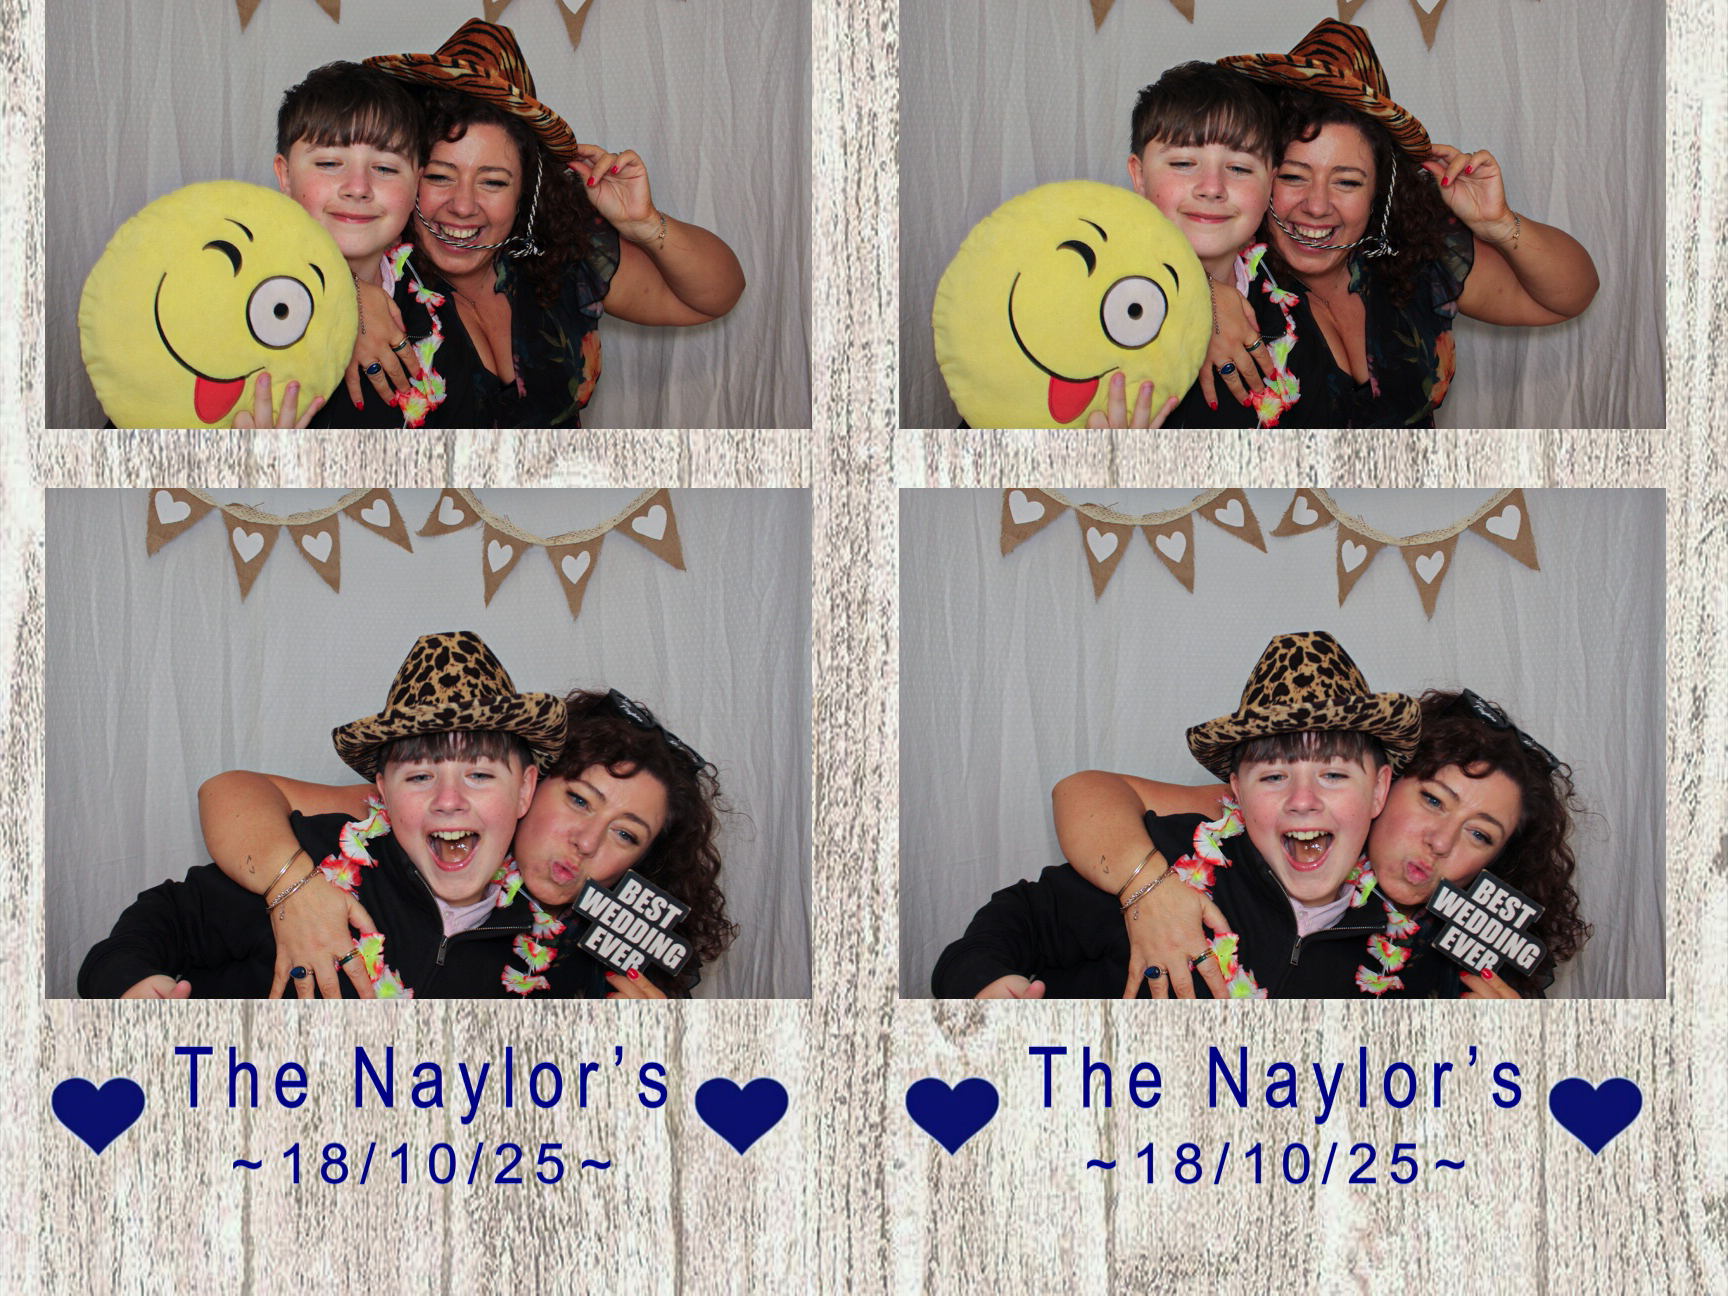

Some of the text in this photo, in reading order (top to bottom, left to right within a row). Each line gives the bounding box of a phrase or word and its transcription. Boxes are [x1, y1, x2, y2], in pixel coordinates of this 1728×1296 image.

[578, 886, 687, 970] WEDDING
[617, 877, 684, 929] BEST
[1432, 886, 1541, 970] WEDDING
[1471, 877, 1538, 929] BEST
[585, 925, 646, 972] EVER
[1439, 925, 1500, 972] EVER
